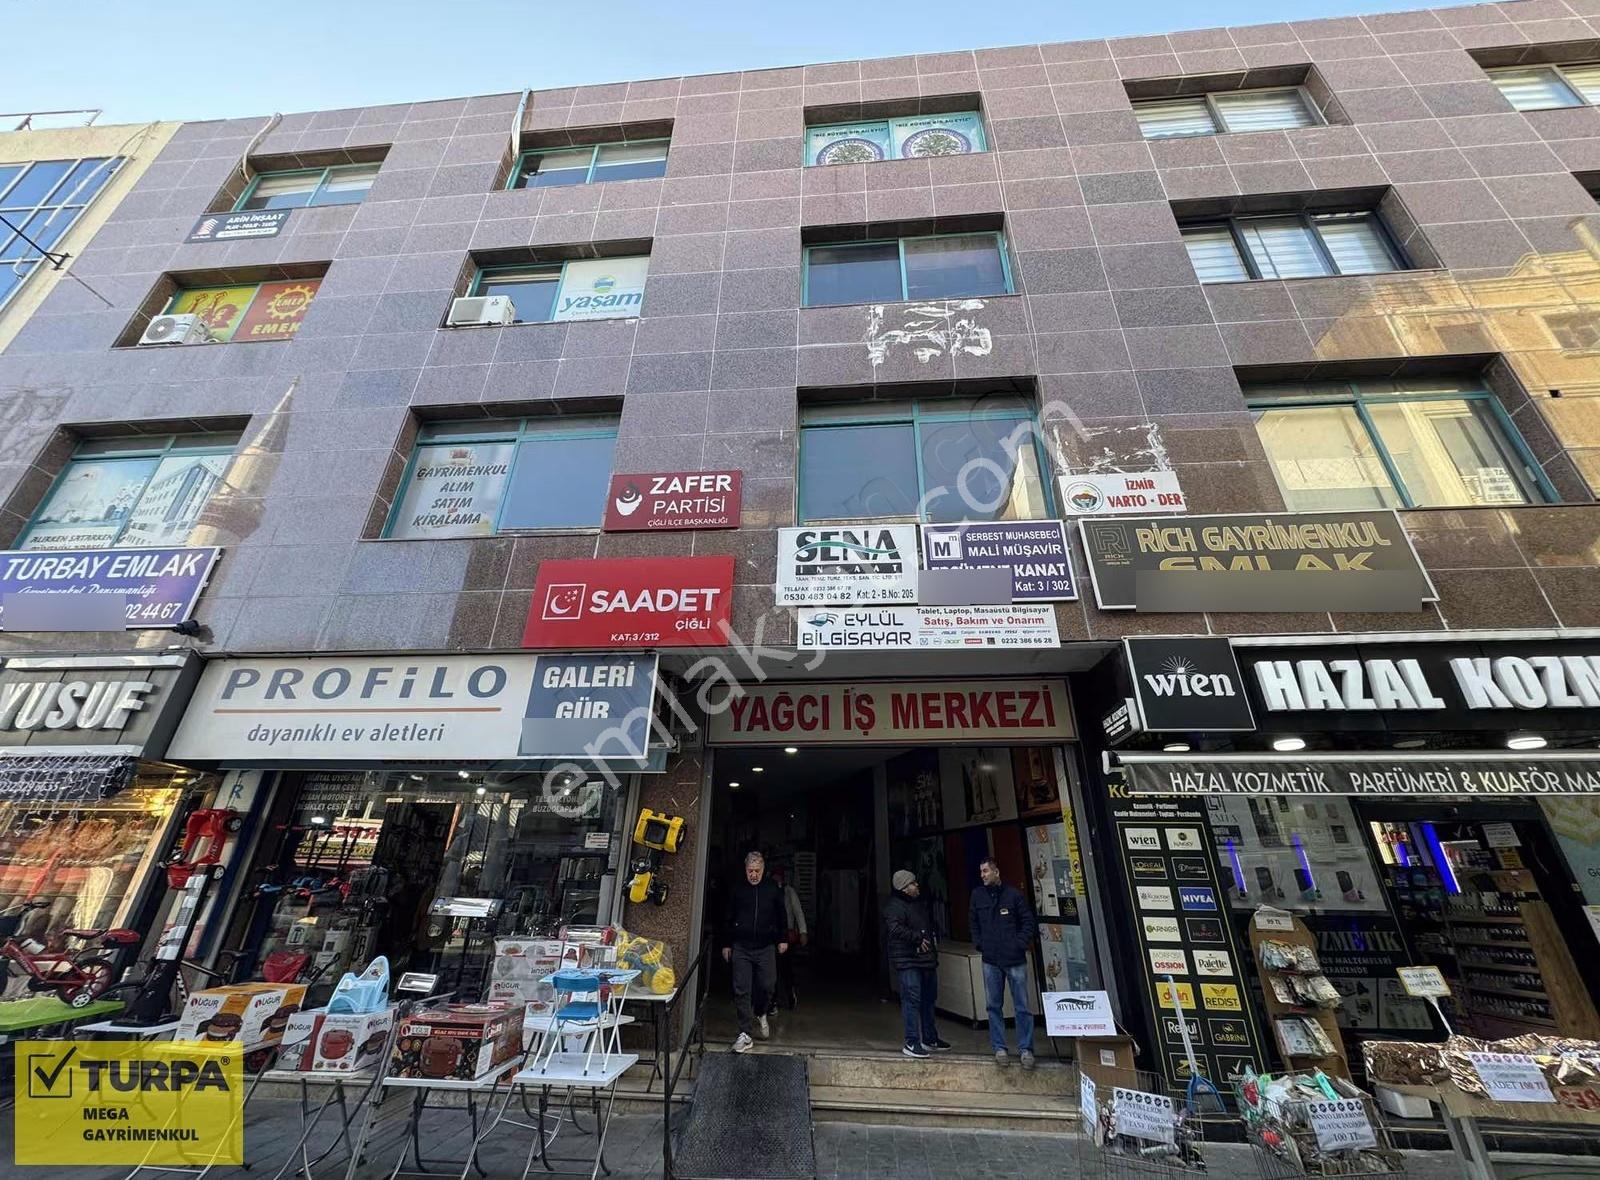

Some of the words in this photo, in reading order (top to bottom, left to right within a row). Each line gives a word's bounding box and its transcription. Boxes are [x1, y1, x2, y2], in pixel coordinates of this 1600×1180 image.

[558, 292, 643, 313] yaşam
[417, 464, 508, 478] GAYRİMENKUL
[440, 482, 474, 492] ALIM
[650, 474, 732, 494] ZAFER
[1125, 478, 1156, 490] İZMİR
[432, 497, 473, 509] SATIM
[653, 496, 725, 514] PARTİSİ
[1107, 496, 1147, 508] VARTO
[1157, 493, 1183, 506] DER
[412, 511, 481, 526] KİRALAMA
[966, 532, 1004, 542] SERBEST
[1006, 528, 1060, 540] MUHASEBECİ
[1136, 522, 1198, 552] RİCH
[1202, 520, 1392, 551] GAYRİMENKUL
[794, 530, 900, 562] SENA
[968, 546, 1000, 557] MALİ
[1003, 542, 1062, 558] MÜŞAVİR
[3, 556, 110, 580] TURBAY
[106, 554, 204, 578] EMLAK
[1013, 563, 1066, 578] KANAT
[872, 590, 876, 598] 2
[902, 588, 914, 598] 205
[1014, 580, 1036, 592] Kat:
[1038, 581, 1044, 590] 3
[1052, 580, 1070, 590] 302
[589, 588, 720, 613] SAADET
[840, 592, 852, 600] 82
[142, 604, 158, 618] 44
[161, 603, 182, 618] 67
[844, 610, 904, 626] EYLÜL
[944, 607, 972, 615] Laptop,
[974, 606, 1010, 614] Masaüstü
[1012, 606, 1050, 614] Bilgisayar
[674, 618, 711, 631] ÇİĞLİ
[924, 617, 954, 626] Satış,
[956, 616, 988, 625] Bakım
[1006, 616, 1045, 624] Onarım
[802, 629, 912, 646] BİLGİSAYAR
[542, 662, 635, 688] GALERİ
[1144, 666, 1236, 698] wien
[1253, 658, 1447, 712] HAZAL
[0, 681, 154, 730] YUSUF
[728, 692, 830, 732] YAĞCI
[842, 688, 876, 736] İŞ
[891, 684, 1056, 730] MERKEZİ
[247, 724, 337, 746] dayanıklı
[341, 728, 364, 742] ev
[368, 722, 444, 742] aletleri
[1170, 772, 1231, 792] HAZAL
[1233, 766, 1330, 792] KOZMETİK
[1351, 766, 1457, 792] PARFÜMERİ
[1460, 772, 1478, 792] &
[1478, 766, 1566, 792] KUAFÖR
[1130, 836, 1156, 846] wien
[1182, 895, 1214, 903] NIVEA
[1154, 962, 1185, 970] OSSION
[1199, 958, 1228, 969] Palette
[1167, 1021, 1198, 1034] Reul
[1333, 1132, 1347, 1142] 100
[1348, 1132, 1358, 1141] TL
